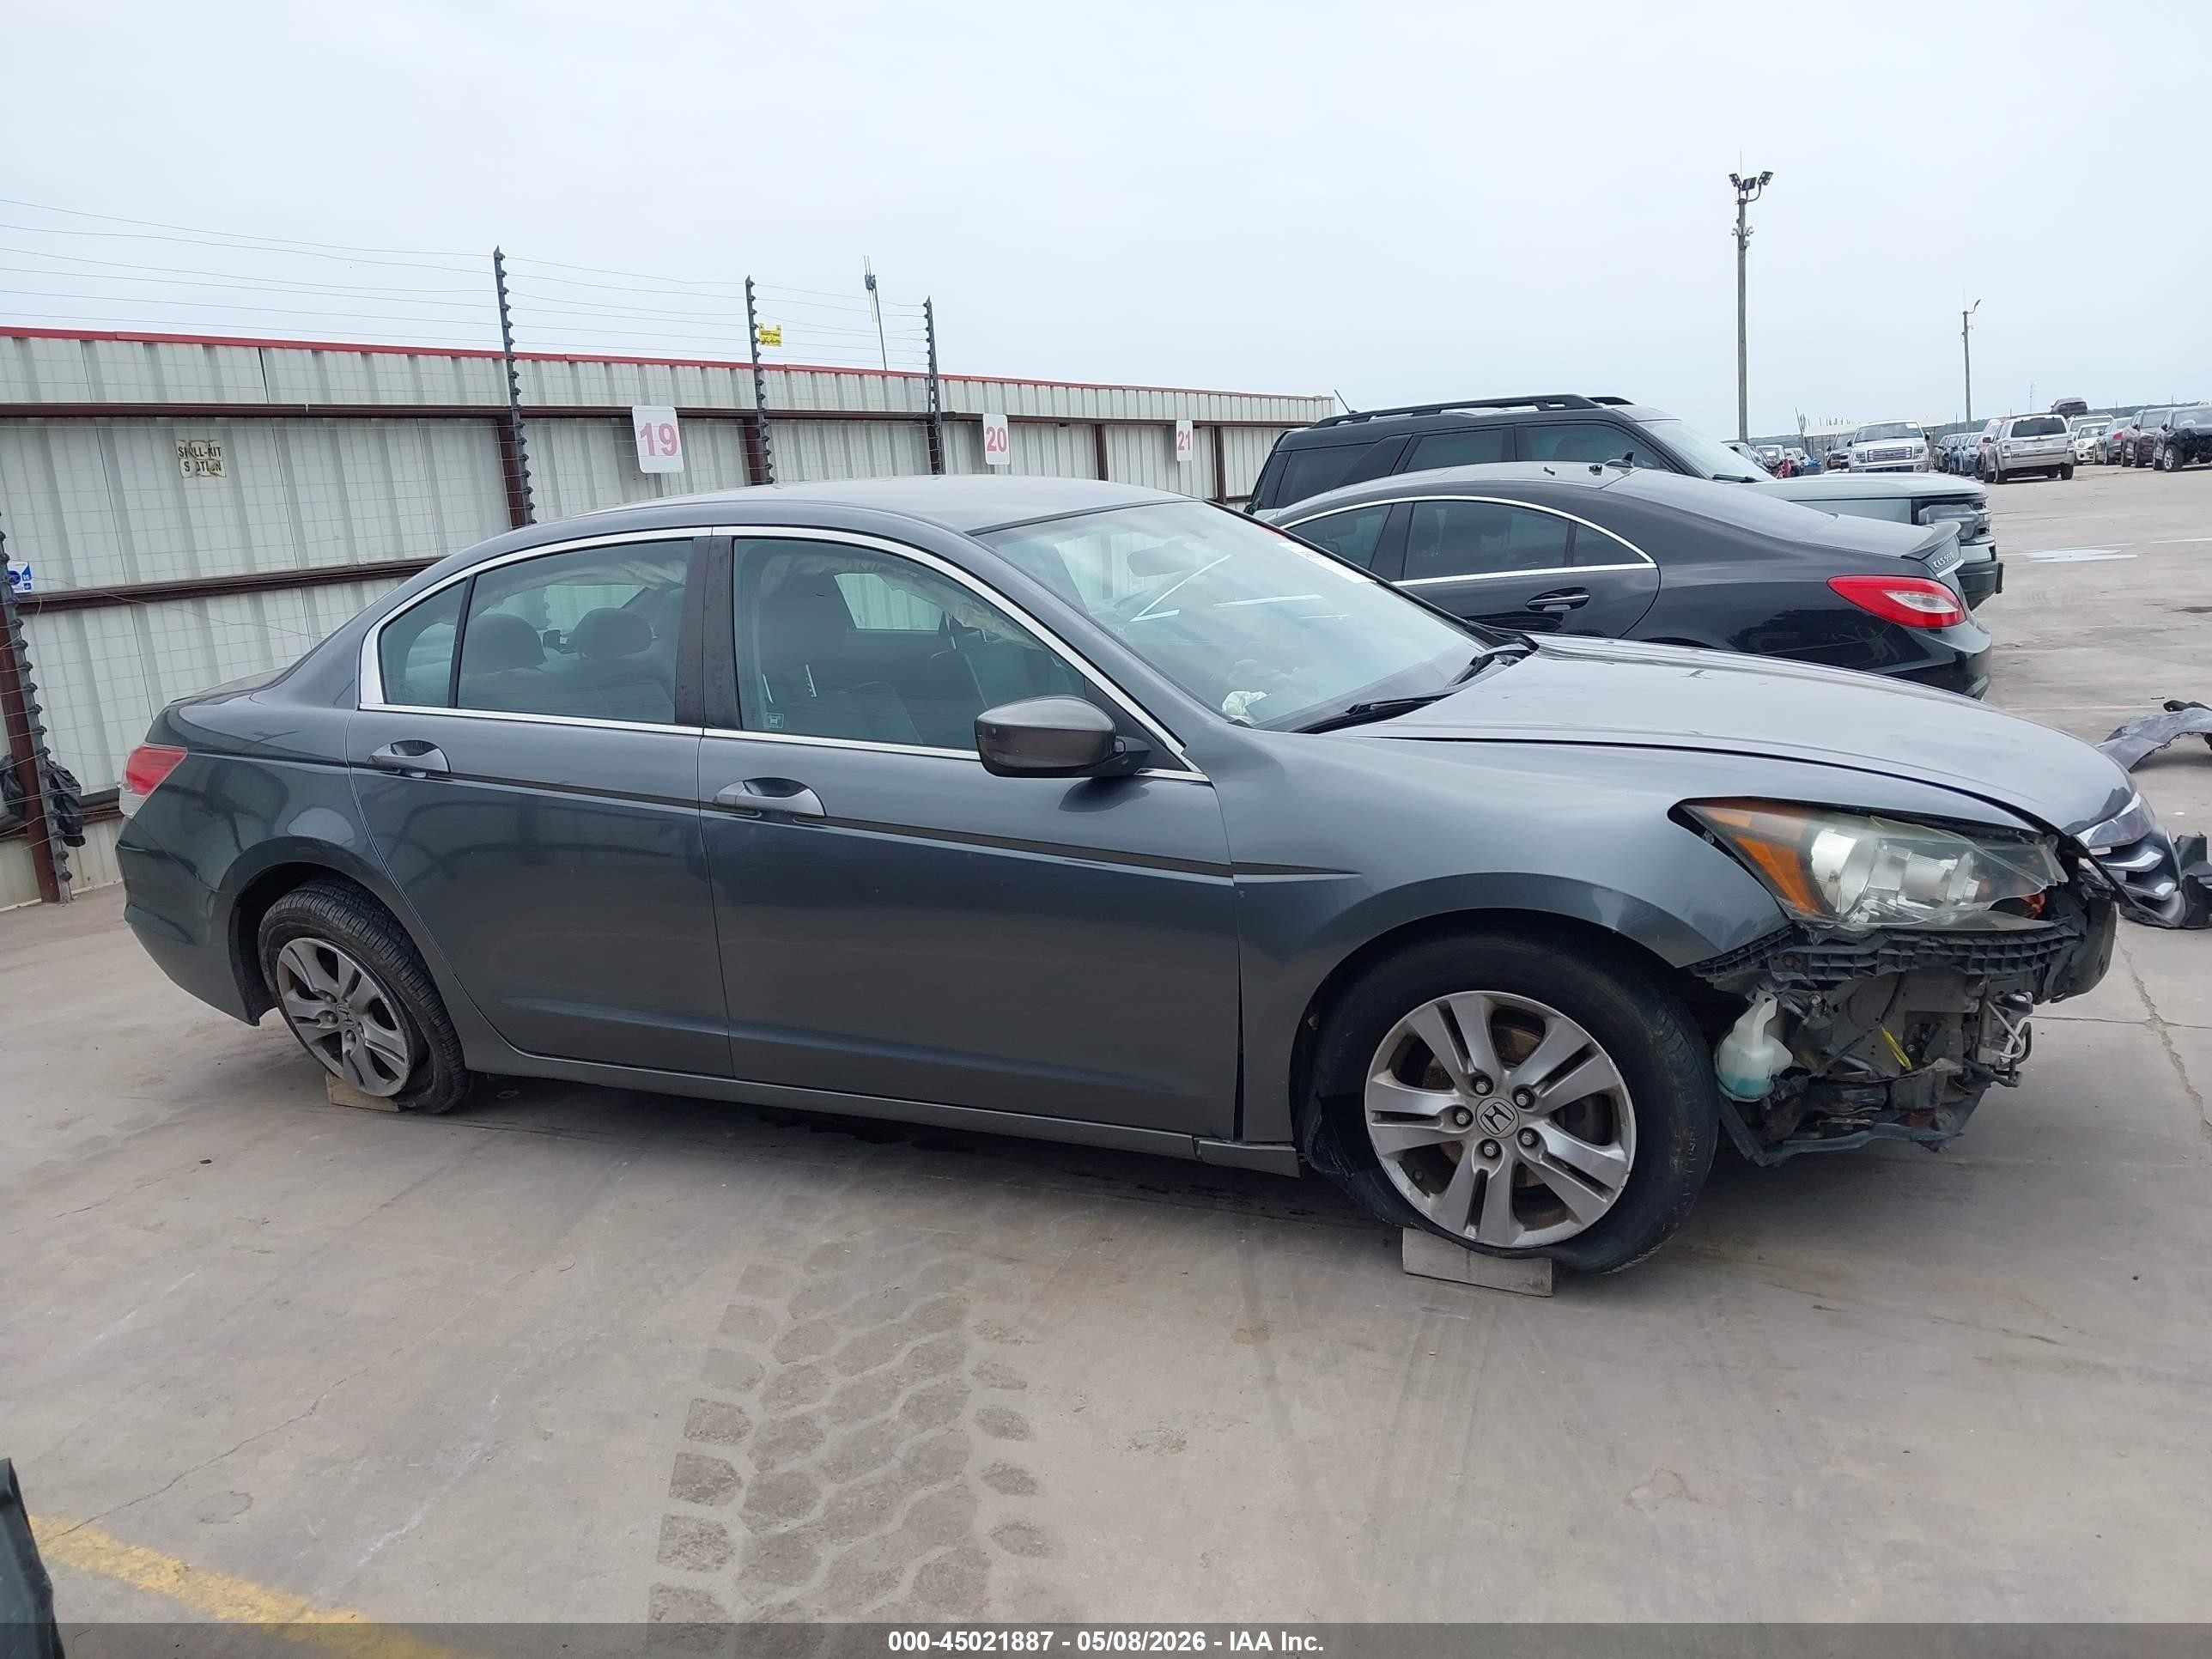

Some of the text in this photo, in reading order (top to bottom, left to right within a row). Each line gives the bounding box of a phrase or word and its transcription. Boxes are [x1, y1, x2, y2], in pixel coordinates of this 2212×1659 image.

[640, 422, 678, 456] 19
[986, 426, 1007, 453] 20
[1177, 429, 1191, 451] 21
